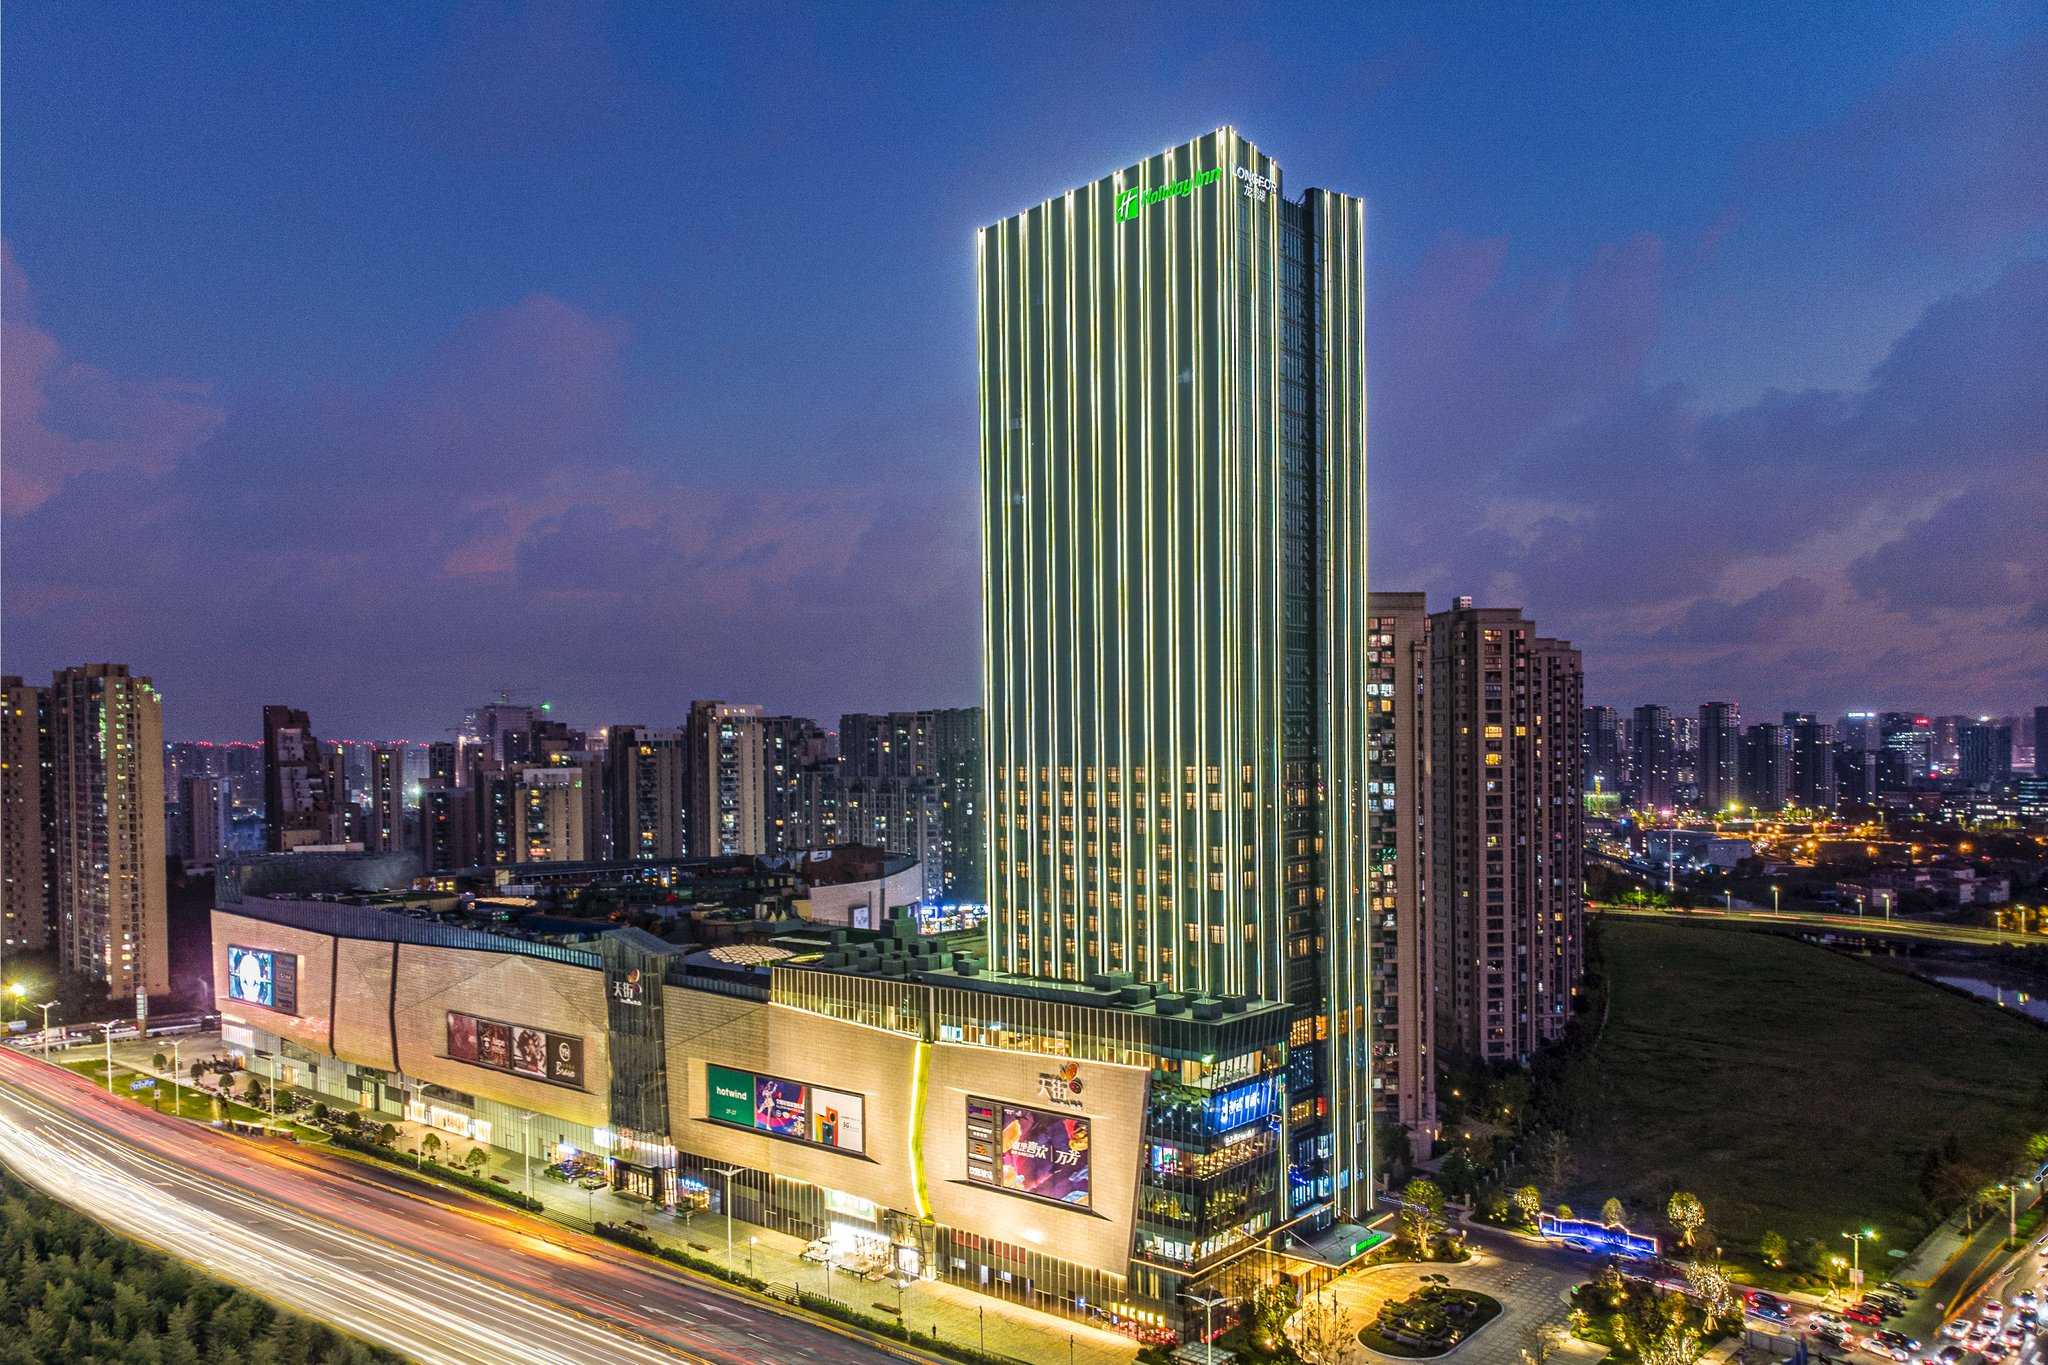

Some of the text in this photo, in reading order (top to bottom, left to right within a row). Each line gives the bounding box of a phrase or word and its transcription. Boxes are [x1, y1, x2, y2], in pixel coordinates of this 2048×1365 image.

[1141, 178, 1193, 208] Holiday
[1195, 166, 1222, 189] Inn
[716, 1085, 747, 1100] hotwind
[1038, 1077, 1068, 1101] 天街
